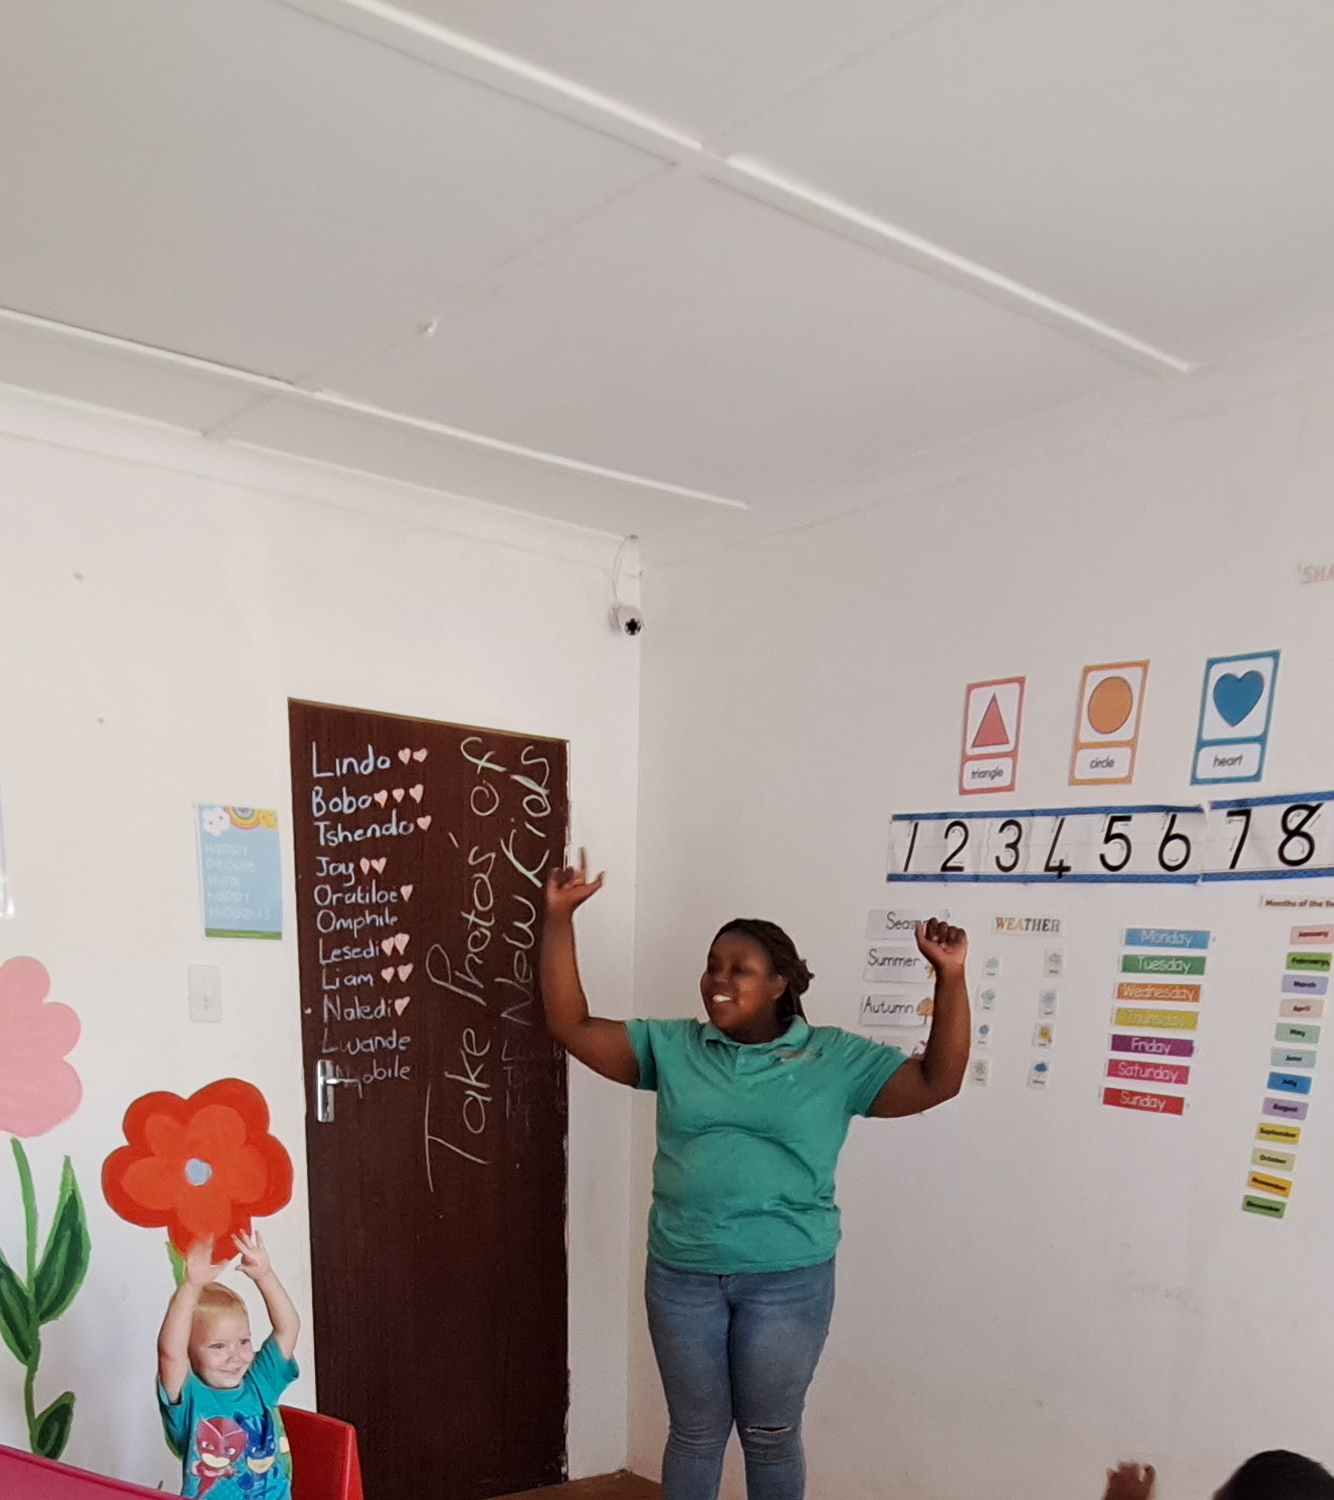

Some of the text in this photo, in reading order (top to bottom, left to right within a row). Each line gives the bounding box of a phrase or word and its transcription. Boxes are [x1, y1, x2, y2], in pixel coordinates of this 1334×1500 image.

[1089, 757, 1115, 769] circle
[1213, 754, 1244, 767] heart
[971, 766, 1004, 781] triangle
[500, 745, 552, 889] Kids
[903, 821, 919, 873] 1
[940, 820, 969, 872] 2
[995, 819, 1023, 873] 3
[1044, 817, 1072, 879] 4
[1099, 814, 1133, 872] 5
[1157, 814, 1192, 873] 6
[1225, 809, 1252, 870] 7
[1277, 802, 1325, 867] 8
[316, 906, 399, 939] Omphile
[995, 917, 1061, 932] WEATHER
[1141, 929, 1195, 946] Monday
[319, 937, 380, 965] Lesedi
[867, 948, 921, 967] Summer
[1138, 956, 1192, 974] Tuesday
[322, 966, 375, 990] Liam
[1123, 984, 1197, 1001] Wednesday
[323, 993, 392, 1023] Naledi
[863, 996, 914, 1015] Autumn
[1130, 1037, 1172, 1055] Friday
[1117, 1061, 1180, 1084] Saturday
[425, 1028, 493, 1193] Take
[1120, 1090, 1167, 1112] Sunday
